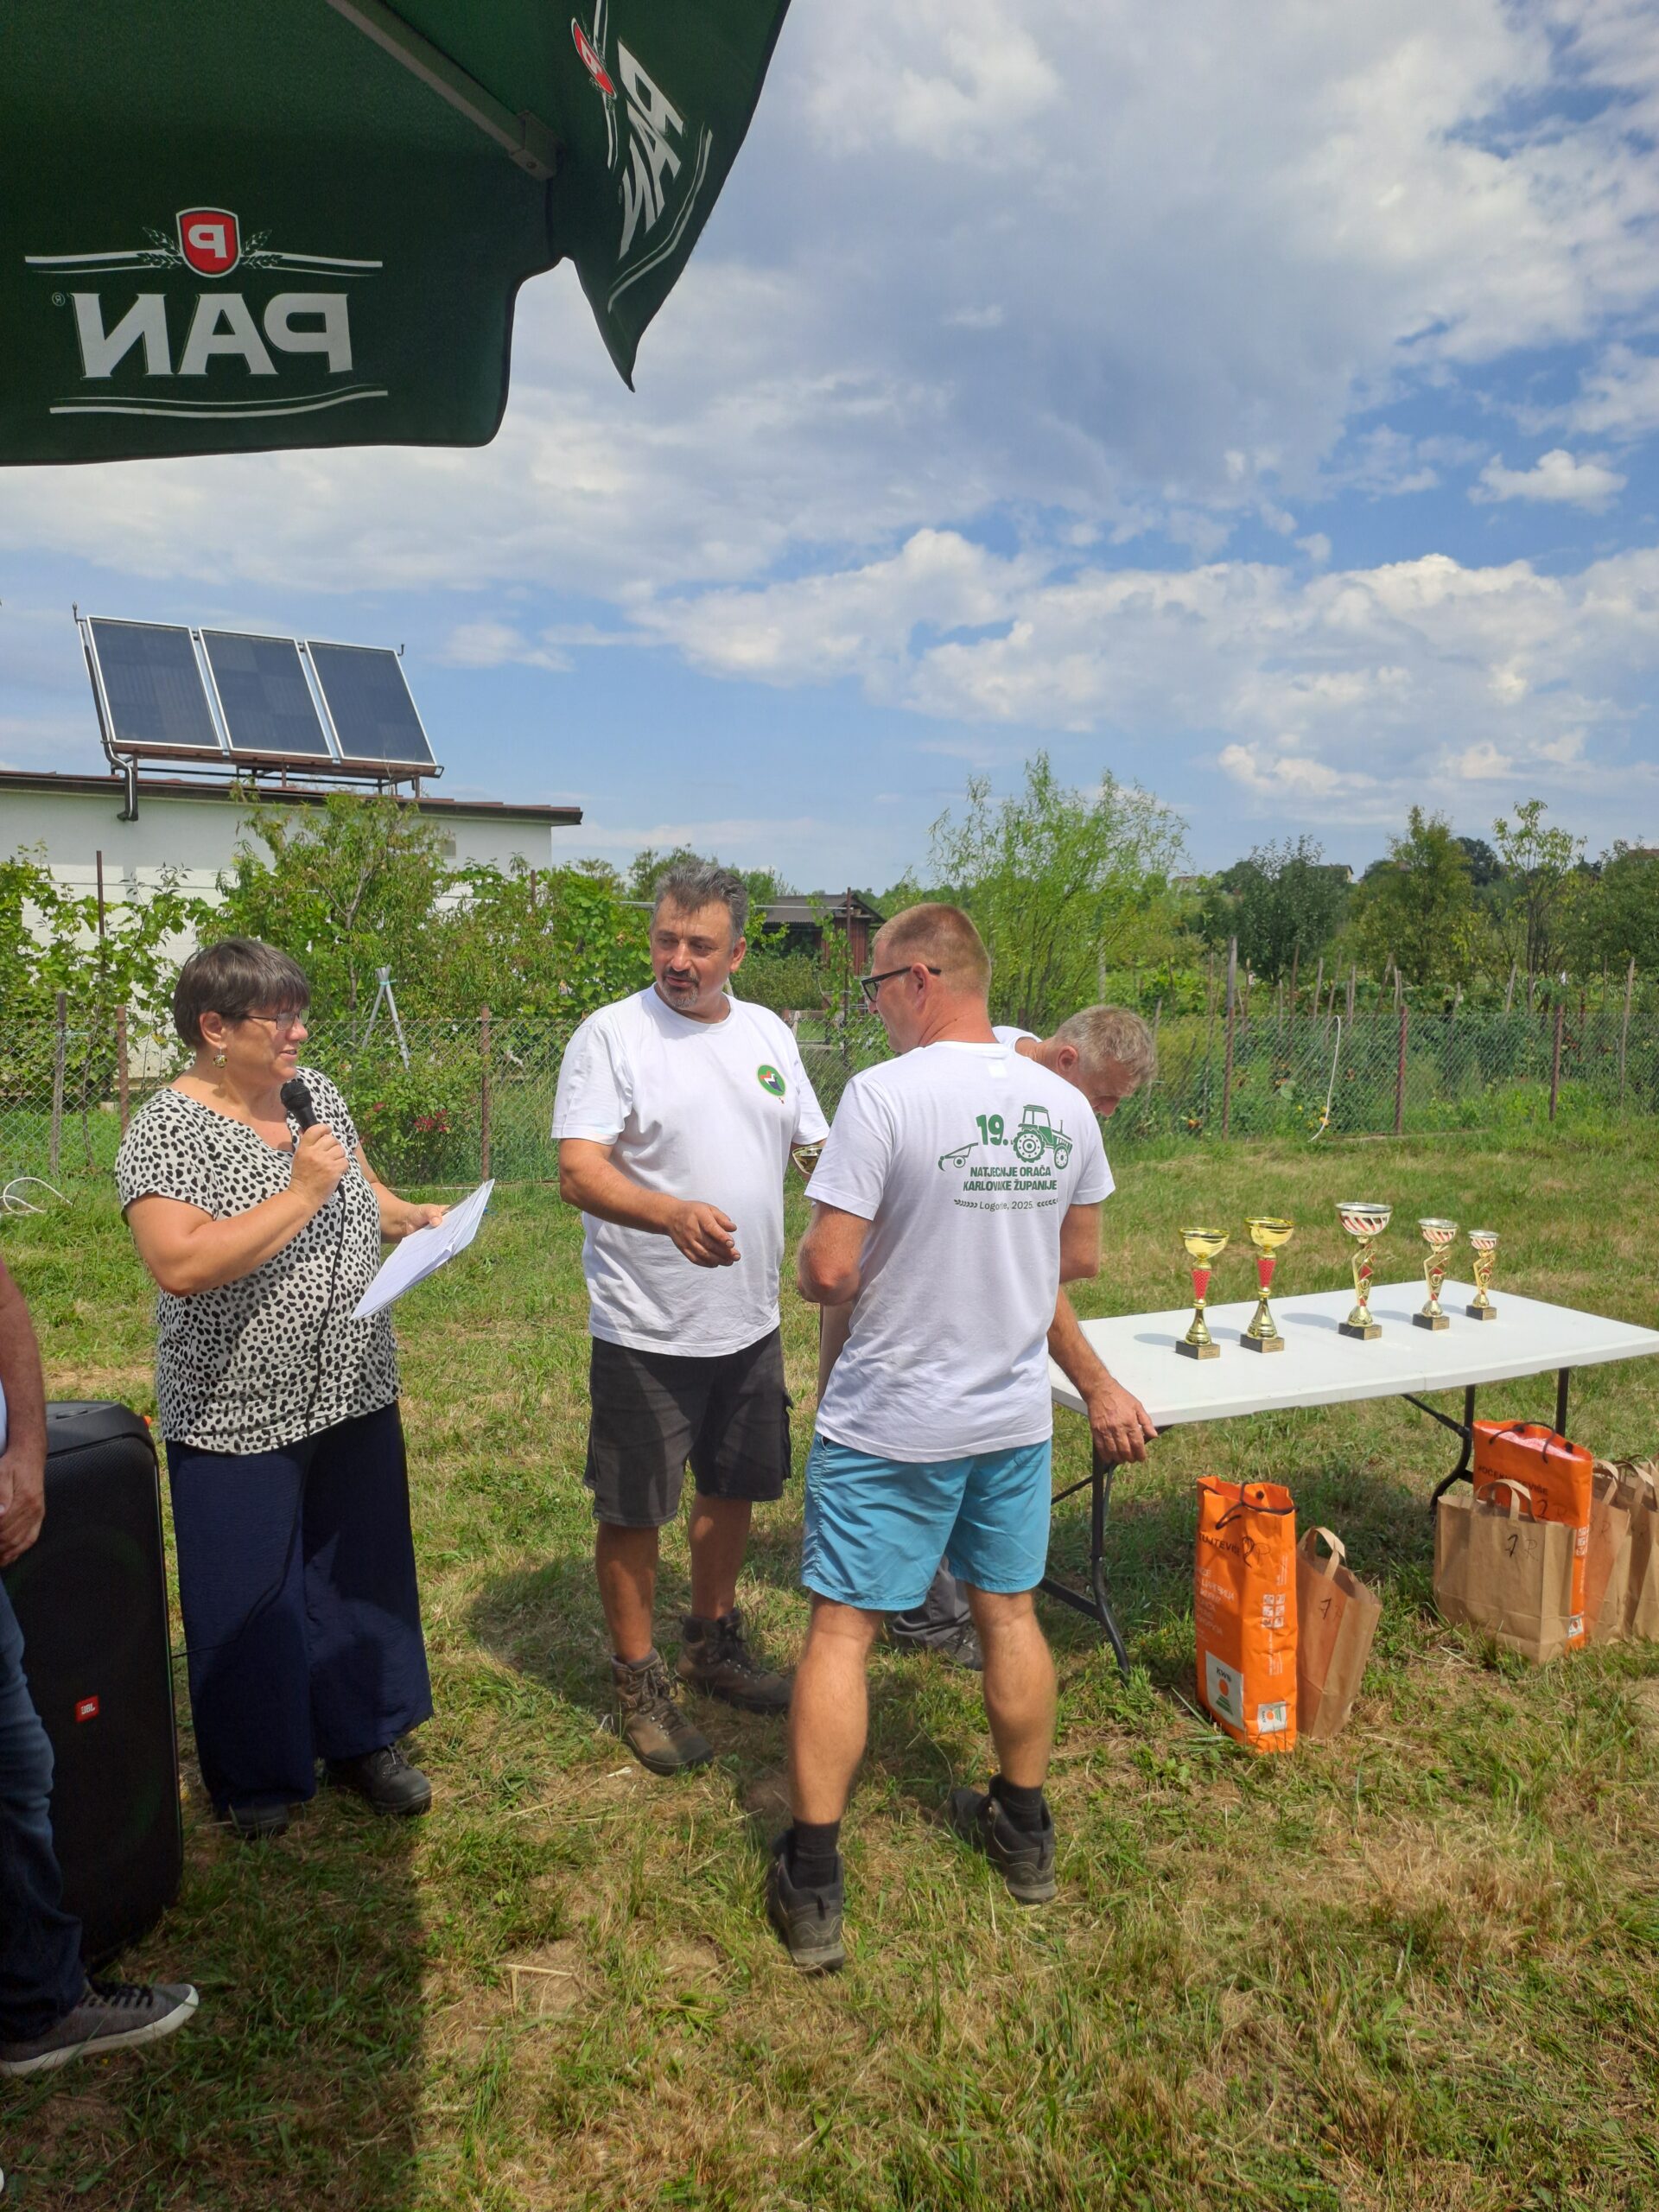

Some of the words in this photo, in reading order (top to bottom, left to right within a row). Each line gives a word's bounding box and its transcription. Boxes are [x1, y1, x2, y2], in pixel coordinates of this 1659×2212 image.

[976, 1114, 1008, 1146] 19.
[1020, 1165, 1052, 1177] ORAČA
[1014, 1179, 1058, 1191] ŽUPANIJE
[80, 1702, 96, 1715] JBL
